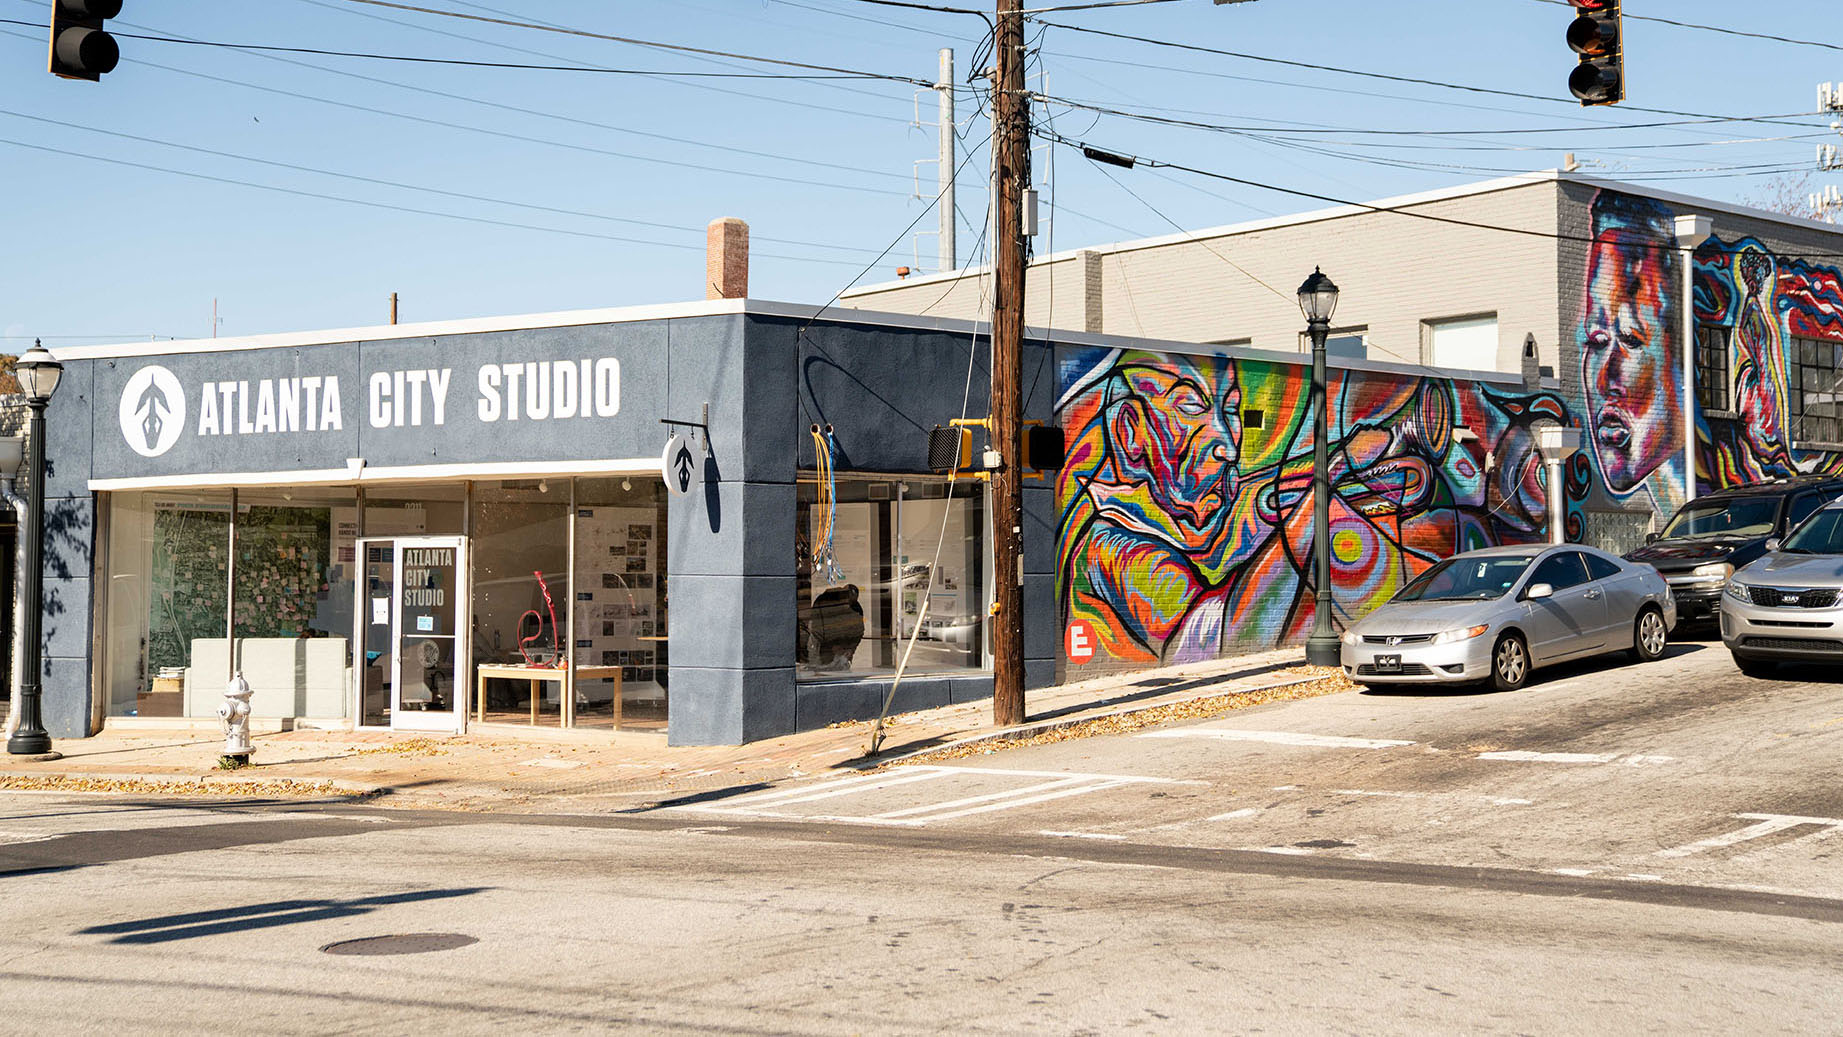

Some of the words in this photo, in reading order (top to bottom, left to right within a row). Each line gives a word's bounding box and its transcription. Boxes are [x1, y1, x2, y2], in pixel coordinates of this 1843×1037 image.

[198, 376, 342, 436] ATLANTA
[369, 368, 452, 428] CITY
[477, 357, 620, 422] STUDIO
[406, 549, 452, 566] ATLANTA
[405, 569, 430, 586] CITY
[404, 589, 444, 606] STUDIO
[1071, 626, 1092, 656] E
